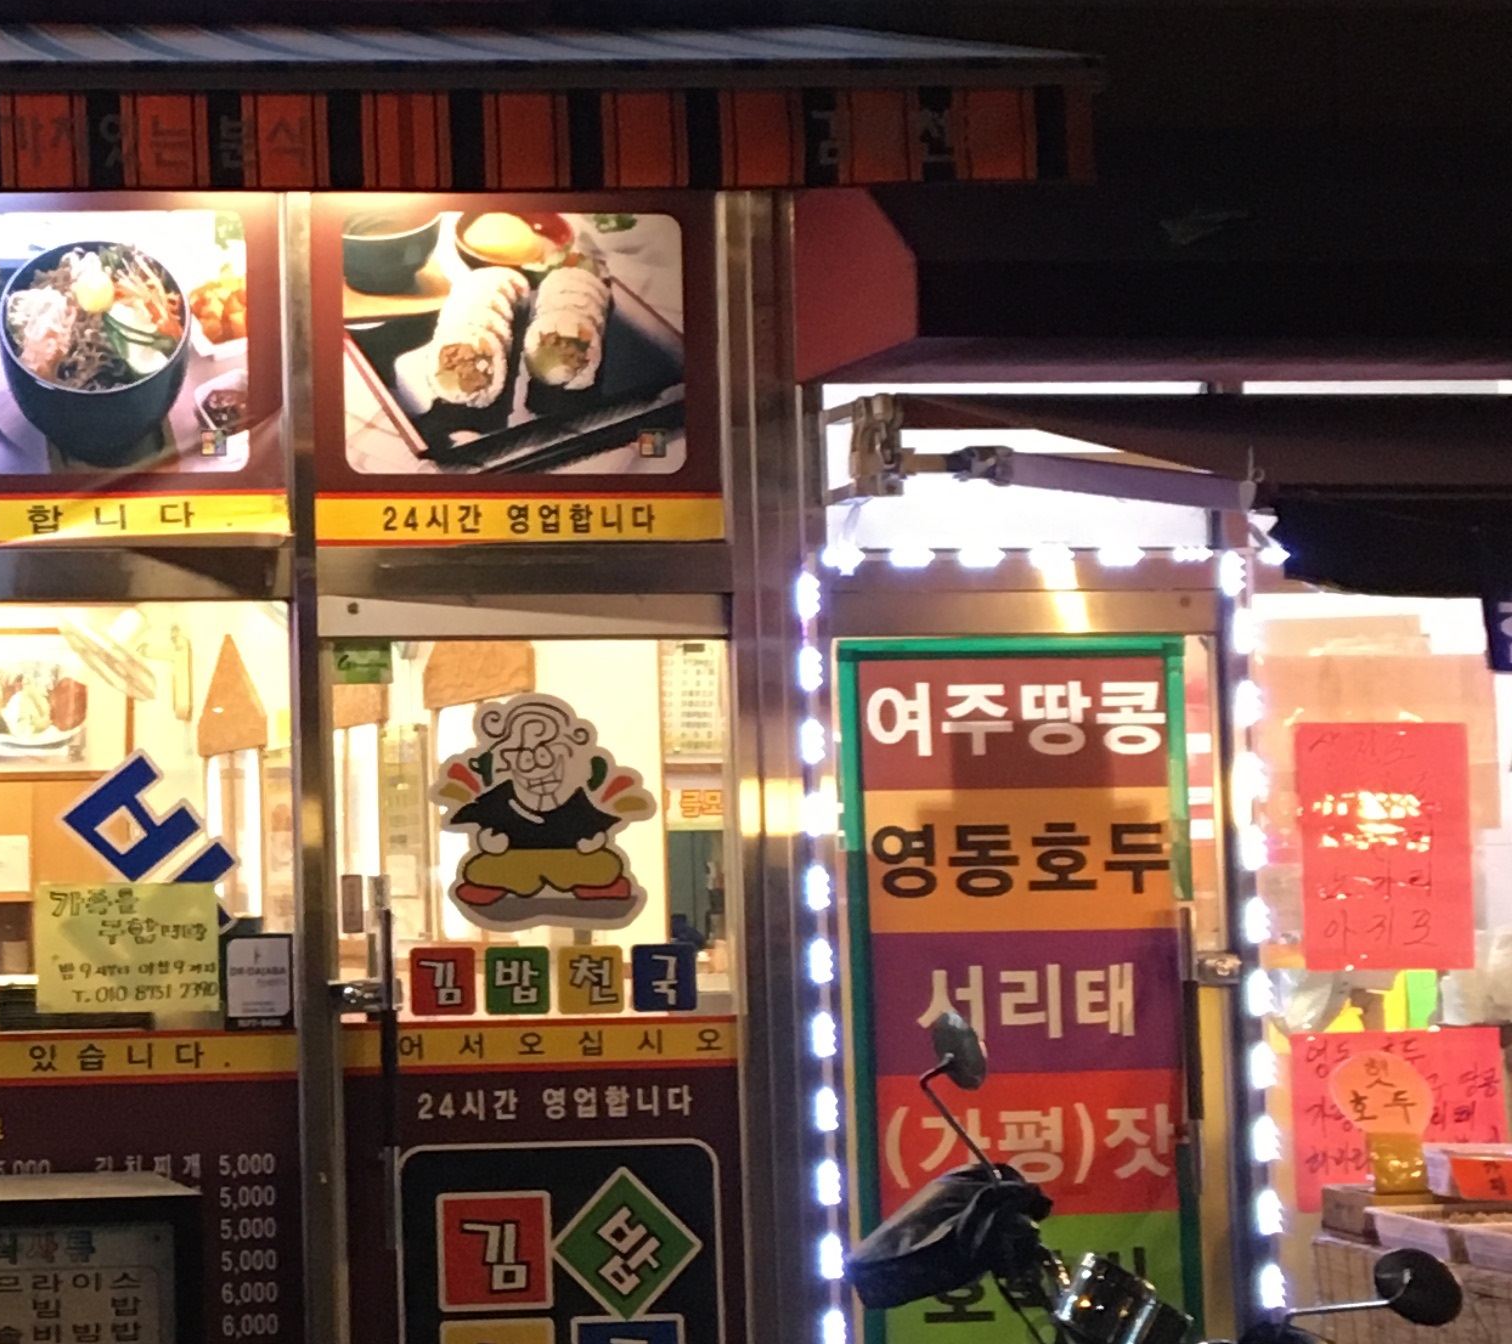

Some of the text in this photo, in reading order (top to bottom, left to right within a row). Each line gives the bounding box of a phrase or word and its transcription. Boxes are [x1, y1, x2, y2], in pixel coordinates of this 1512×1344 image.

[383, 502, 657, 534] 24시간 영업합니다
[866, 680, 1167, 757] 여주땅콩
[872, 822, 1171, 899] 영동호두
[419, 954, 681, 1008] 김밥천국
[916, 962, 1135, 1048] 서리태
[417, 1084, 694, 1123] 24시간 영업합니다
[219, 1153, 275, 1179] 5,000
[219, 1185, 276, 1211] 5,000
[219, 1217, 277, 1243] 5,000
[220, 1249, 278, 1274] 5,000
[221, 1281, 279, 1306] 6,000
[222, 1313, 279, 1338] 6,000
